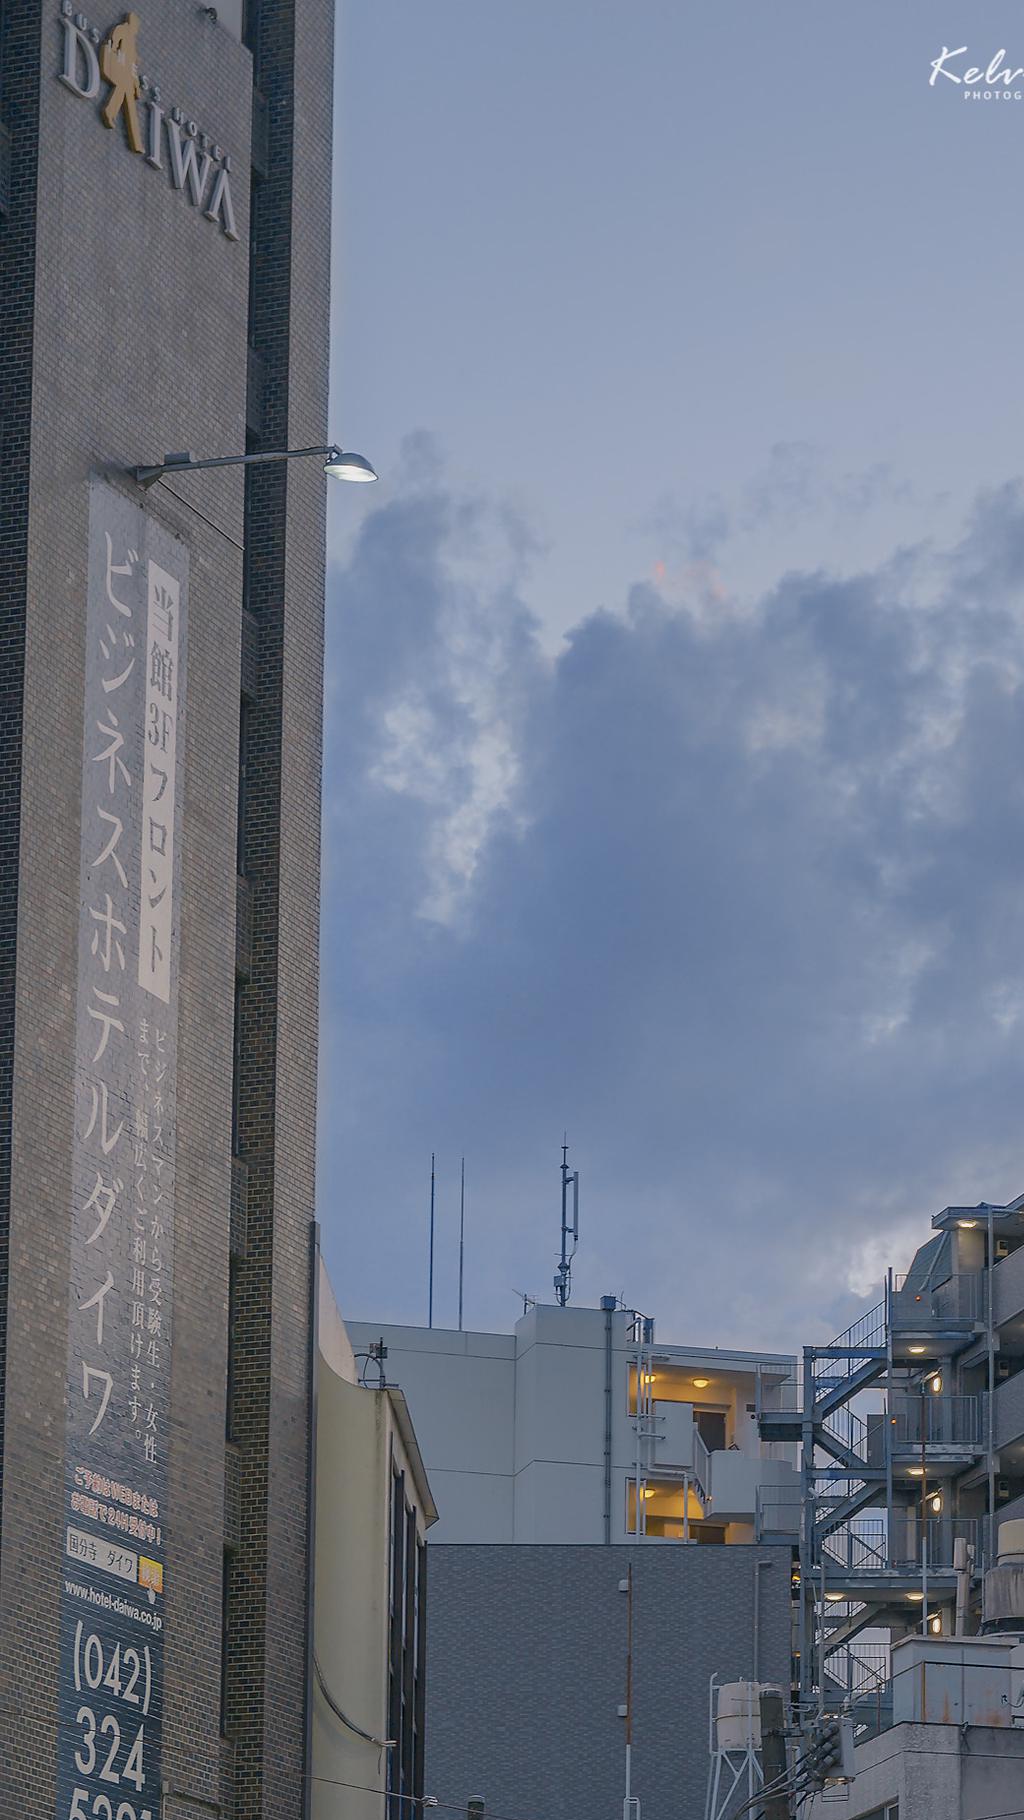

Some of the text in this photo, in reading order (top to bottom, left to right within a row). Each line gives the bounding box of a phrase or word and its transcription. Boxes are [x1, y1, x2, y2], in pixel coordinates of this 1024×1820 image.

[172, 107, 231, 173] HOTEL
[147, 583, 174, 973] 当館3Fフロント
[78, 530, 140, 1436] ビジネスホテルダイワ
[70, 1535, 133, 1573] 国分寺 ダイワ
[65, 1580, 162, 1631] www.hotel-daiwa.co.jp
[74, 1620, 152, 1715] (042)
[74, 1706, 146, 1792] 324
